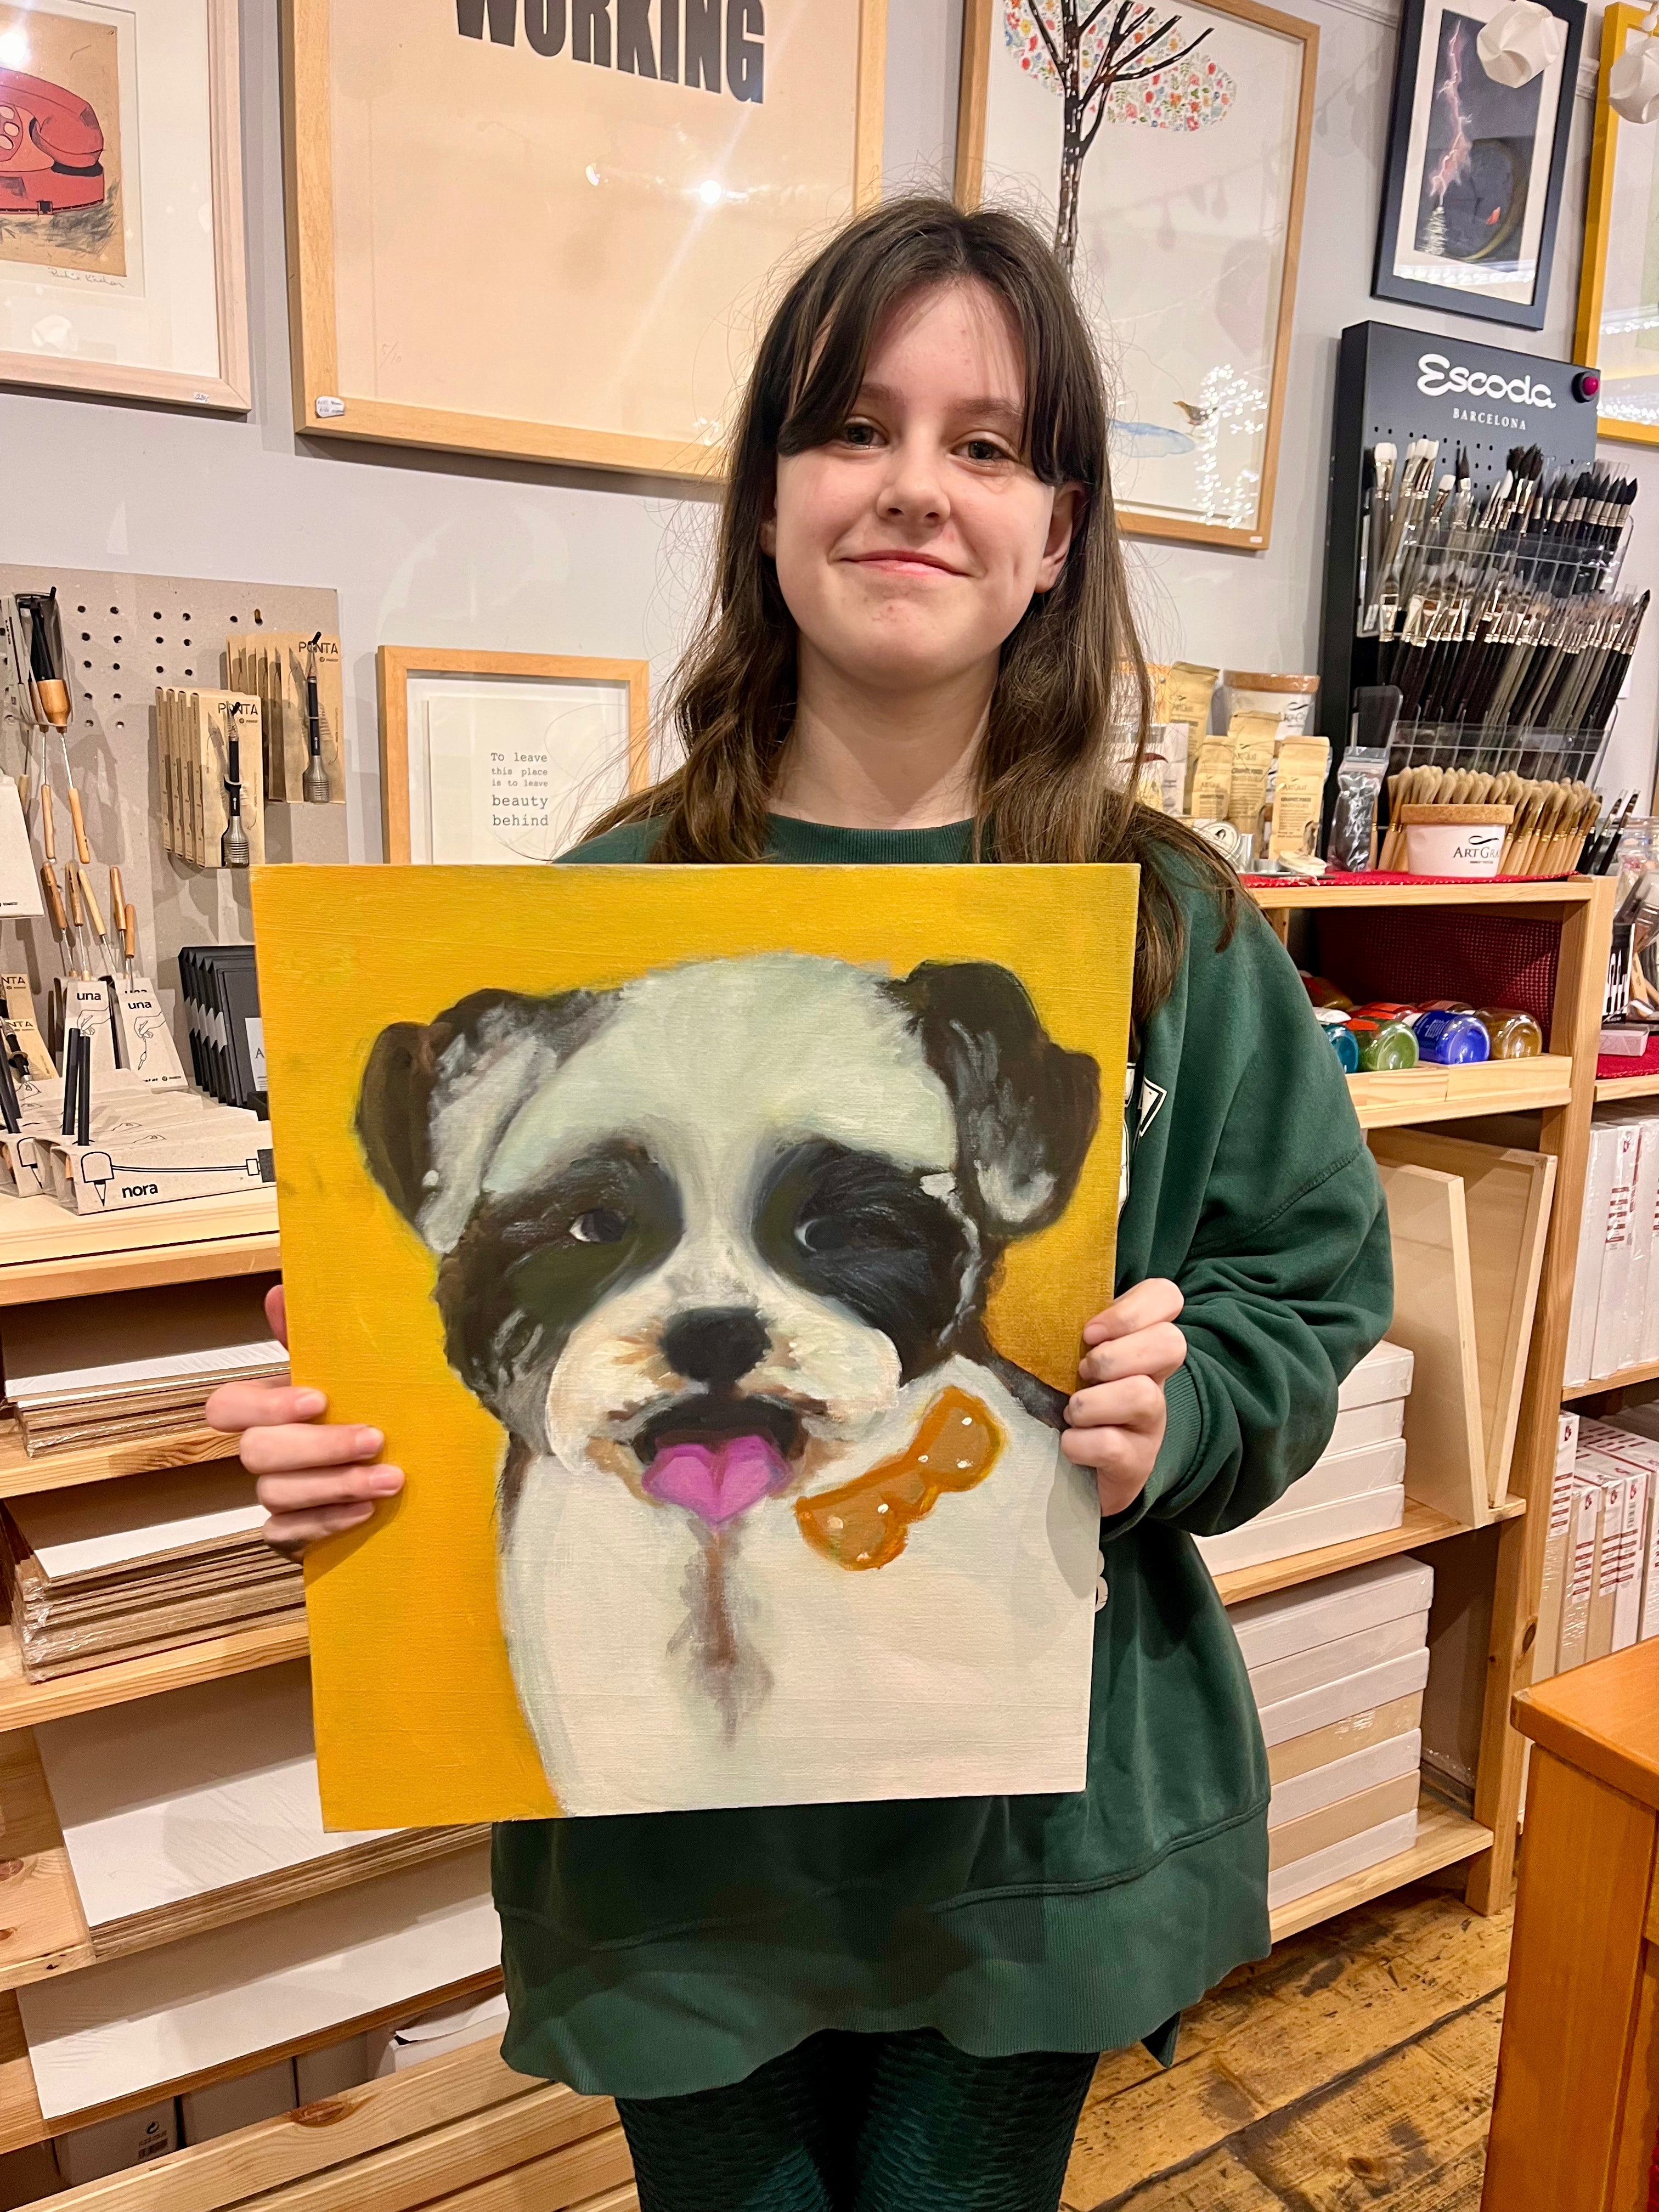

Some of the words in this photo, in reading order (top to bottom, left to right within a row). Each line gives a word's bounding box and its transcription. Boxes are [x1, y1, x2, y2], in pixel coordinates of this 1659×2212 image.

[1417, 353, 1556, 409] Escoda
[1453, 408, 1526, 430] BARCELONA
[491, 752, 504, 761] To
[514, 752, 548, 763] leave
[492, 766, 512, 775] this
[521, 768, 548, 777] place
[492, 778, 501, 787] is
[492, 794, 548, 809] beauty
[493, 814, 549, 826] behind
[77, 992, 101, 1001] una
[128, 1001, 152, 1009] una
[122, 1183, 158, 1198] nora
